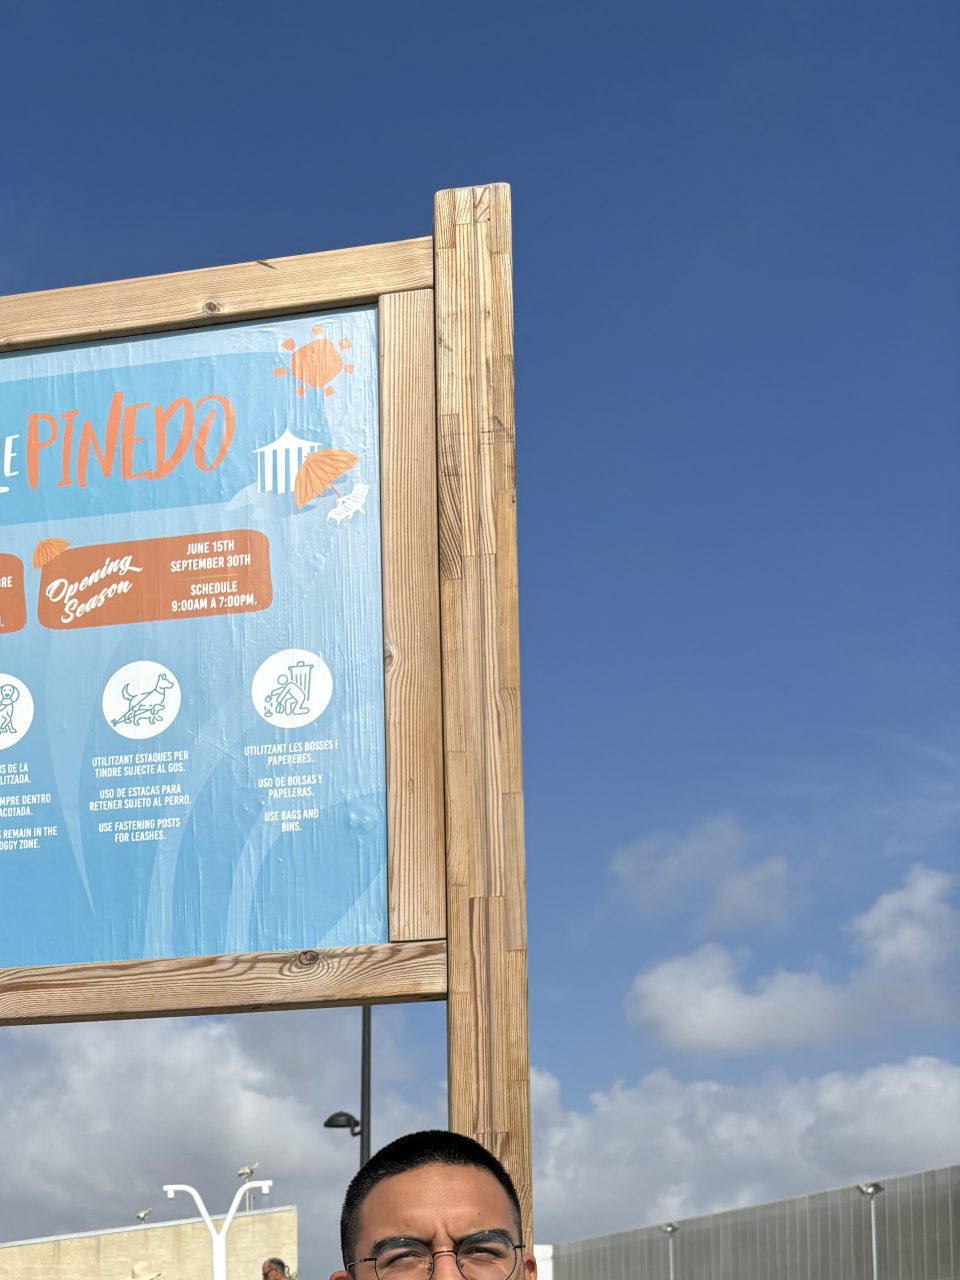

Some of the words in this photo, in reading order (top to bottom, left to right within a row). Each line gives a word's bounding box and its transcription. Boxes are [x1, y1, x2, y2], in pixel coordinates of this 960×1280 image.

[27, 392, 234, 488] PINEDO
[187, 542, 209, 555] JUNE
[212, 540, 234, 553] 15TH
[171, 555, 224, 572] SEPTEMBER
[227, 554, 251, 567] 30TH
[46, 554, 143, 604] Opening
[191, 581, 237, 596] SCHEDULE
[61, 580, 133, 623] Season
[171, 598, 207, 612] 9:00AM
[210, 597, 216, 608] A
[219, 593, 257, 607] 7:00PM.
[244, 743, 287, 756] UTILITZANT
[289, 743, 302, 753] LES
[305, 740, 333, 751] BOSSES
[92, 755, 133, 766] UTILITZANT
[136, 752, 172, 764] ESTAQUES
[174, 751, 188, 760] PER
[268, 753, 314, 766] PAPERERES.
[8, 764, 17, 773] DE
[20, 763, 28, 772] LA
[95, 767, 122, 778] TINDRE
[124, 765, 155, 776] SUJECTE
[157, 764, 166, 773] AL
[168, 763, 185, 772] GOS.
[258, 778, 272, 788] USO
[275, 777, 285, 786] DE
[288, 775, 316, 786] BOLSAS
[318, 774, 323, 784] Y
[22, 794, 51, 804] DENTRO
[100, 789, 114, 799] USO
[117, 788, 126, 797] DE
[128, 786, 160, 797] ESTACAS
[162, 784, 181, 794] PARA
[269, 787, 314, 799] PAPELERAS.
[89, 801, 122, 811] RETENER
[125, 798, 151, 808] SUJETO
[153, 798, 162, 806] AL
[164, 795, 191, 806] PERRO.
[265, 812, 279, 821] USE
[282, 810, 301, 819] BAGS
[303, 809, 319, 819] AND
[3, 828, 31, 839] REMAIN
[34, 828, 41, 836] IN
[44, 826, 57, 836] THE
[99, 822, 112, 832] USE
[115, 820, 155, 831] FASTENING
[157, 818, 180, 828] POSTS
[282, 822, 302, 832] BINS.
[19, 839, 40, 849] ZONE.
[115, 833, 129, 842] FOR
[131, 831, 166, 841] LEASHES.
